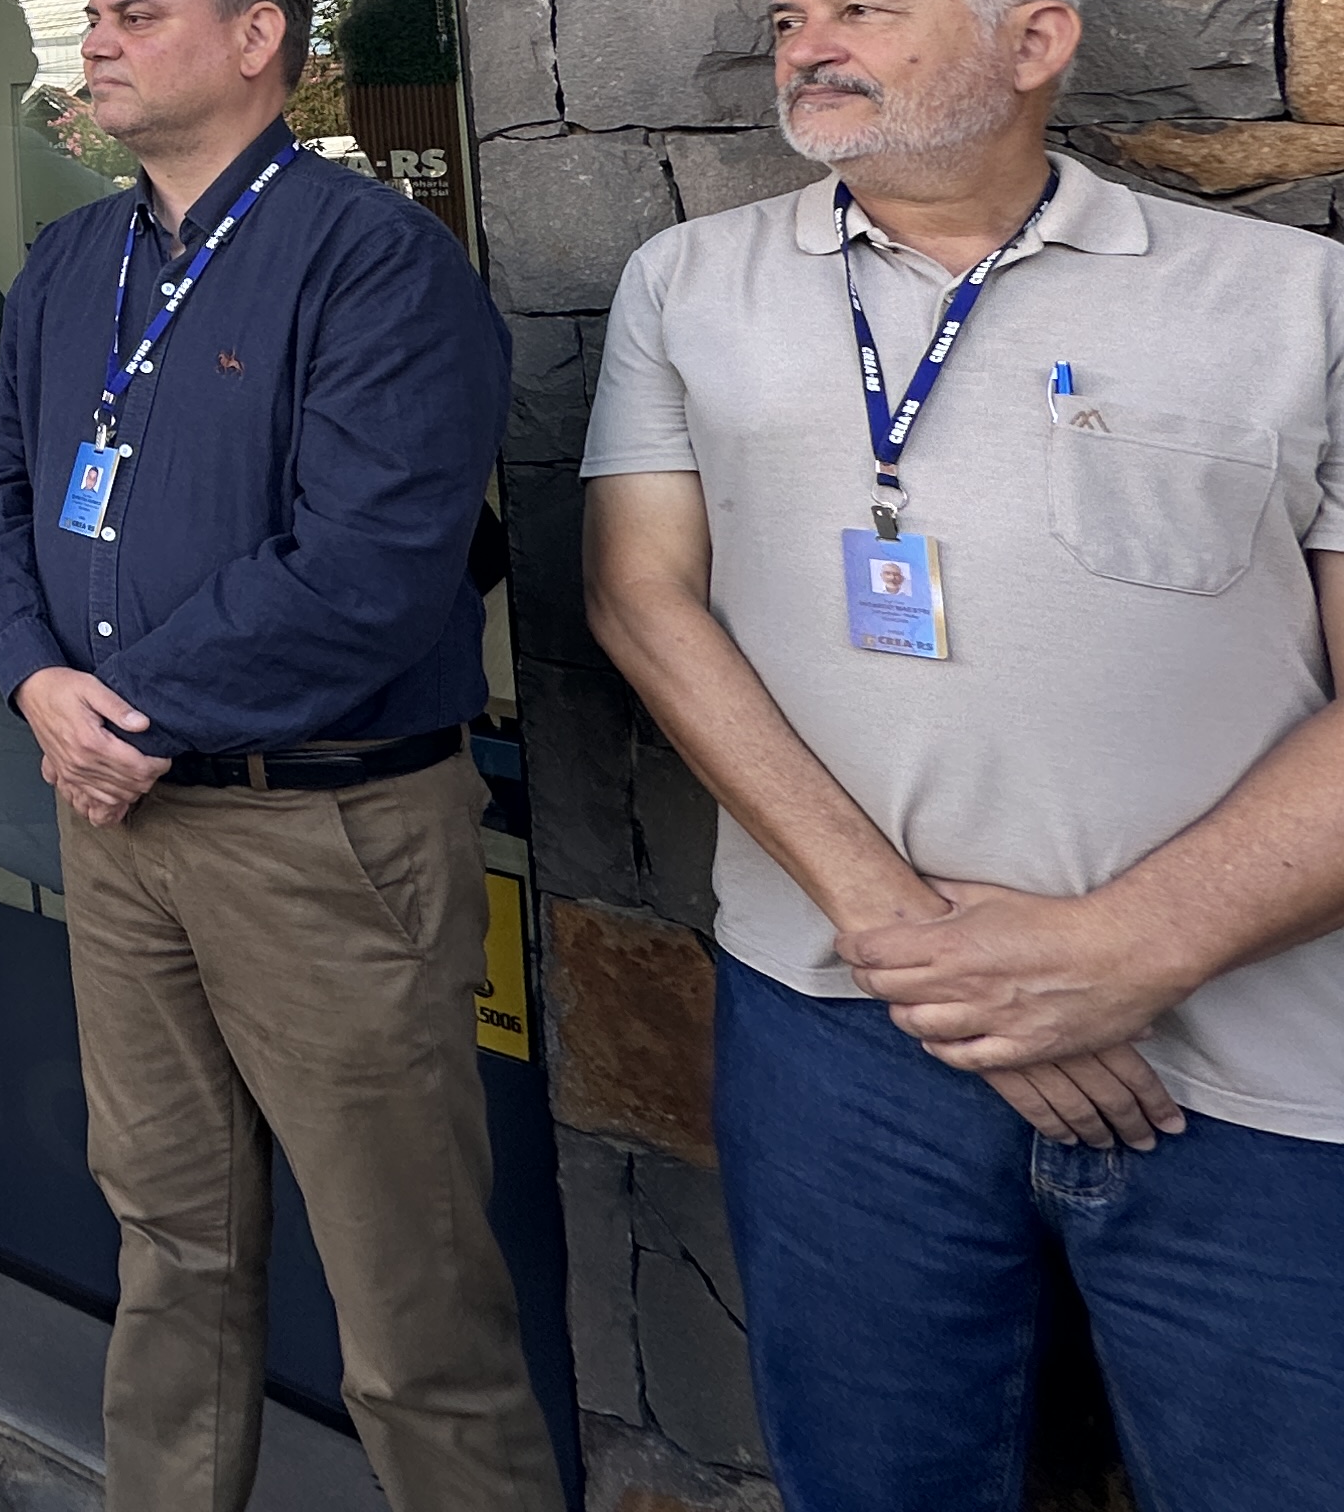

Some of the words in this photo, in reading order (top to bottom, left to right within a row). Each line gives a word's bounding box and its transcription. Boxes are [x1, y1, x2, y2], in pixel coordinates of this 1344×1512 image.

[929, 320, 961, 364] CREA-RS
[862, 346, 881, 392] CREA-RS
[888, 399, 920, 444] CREA-RS
